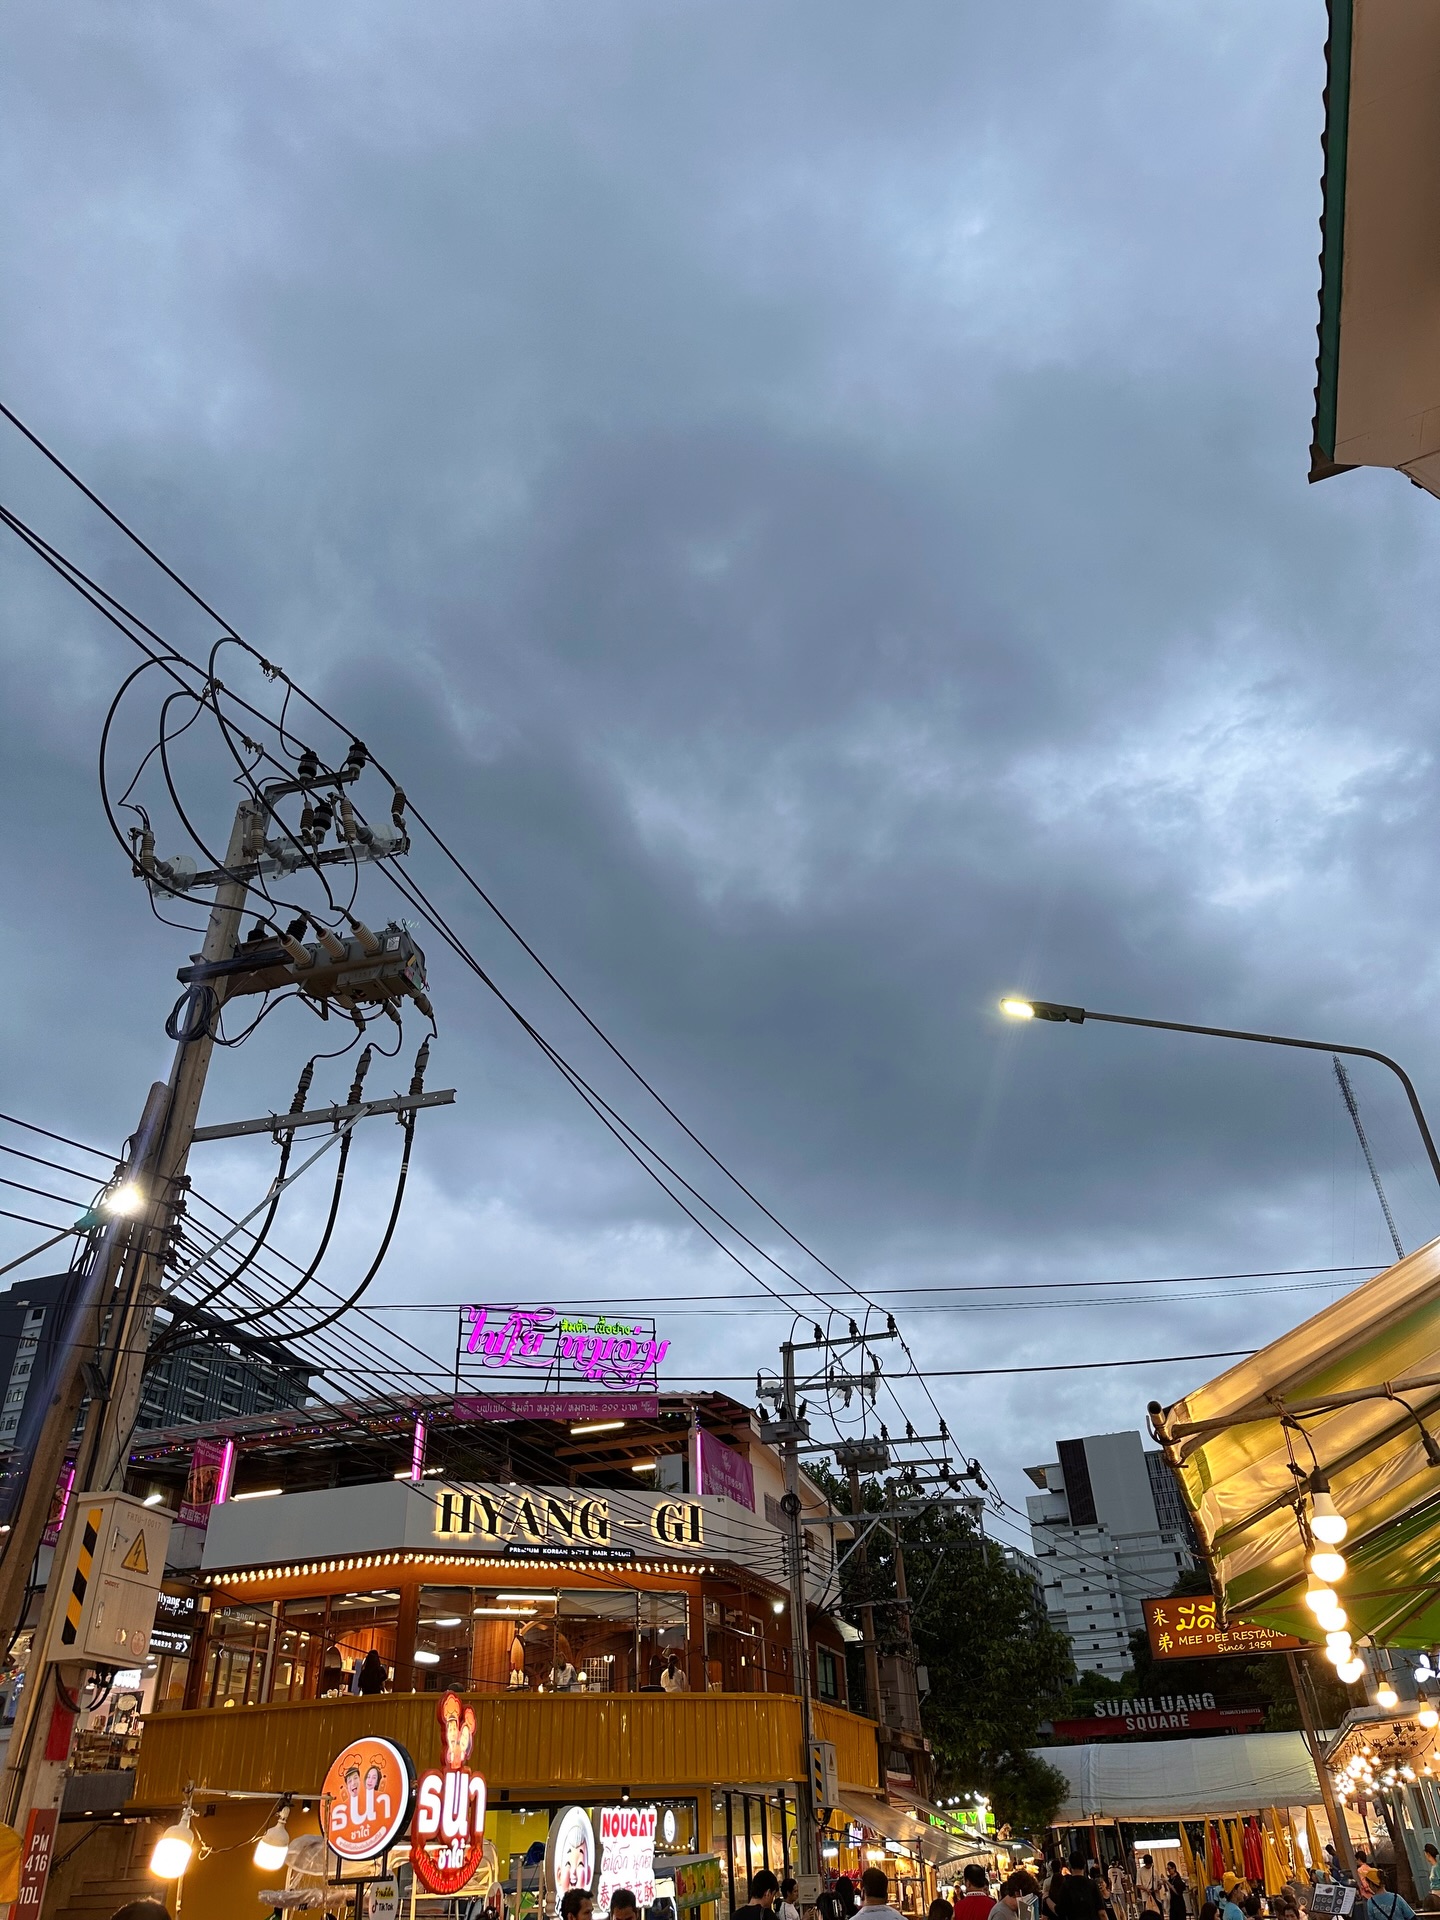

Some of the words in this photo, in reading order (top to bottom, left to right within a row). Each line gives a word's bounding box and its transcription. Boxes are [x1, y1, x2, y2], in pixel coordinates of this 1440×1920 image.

[602, 1403, 619, 1412] 299
[438, 1493, 609, 1540] HYANG
[656, 1502, 702, 1544] GI
[543, 1547, 568, 1555] KOREAN
[1178, 1635, 1202, 1646] MEE
[1206, 1632, 1229, 1643] DEE
[1217, 1643, 1246, 1653] Since
[1248, 1640, 1272, 1650] 1959
[1094, 1691, 1216, 1718] SUANLUANG
[1126, 1713, 1190, 1731] SQUARE
[418, 1771, 486, 1838] ธนา
[602, 1813, 655, 1838] NOUGAT
[31, 1834, 50, 1852] PM
[438, 1838, 465, 1869] ชาใต้
[24, 1854, 48, 1872] 416
[19, 1886, 39, 1904] 1DL
